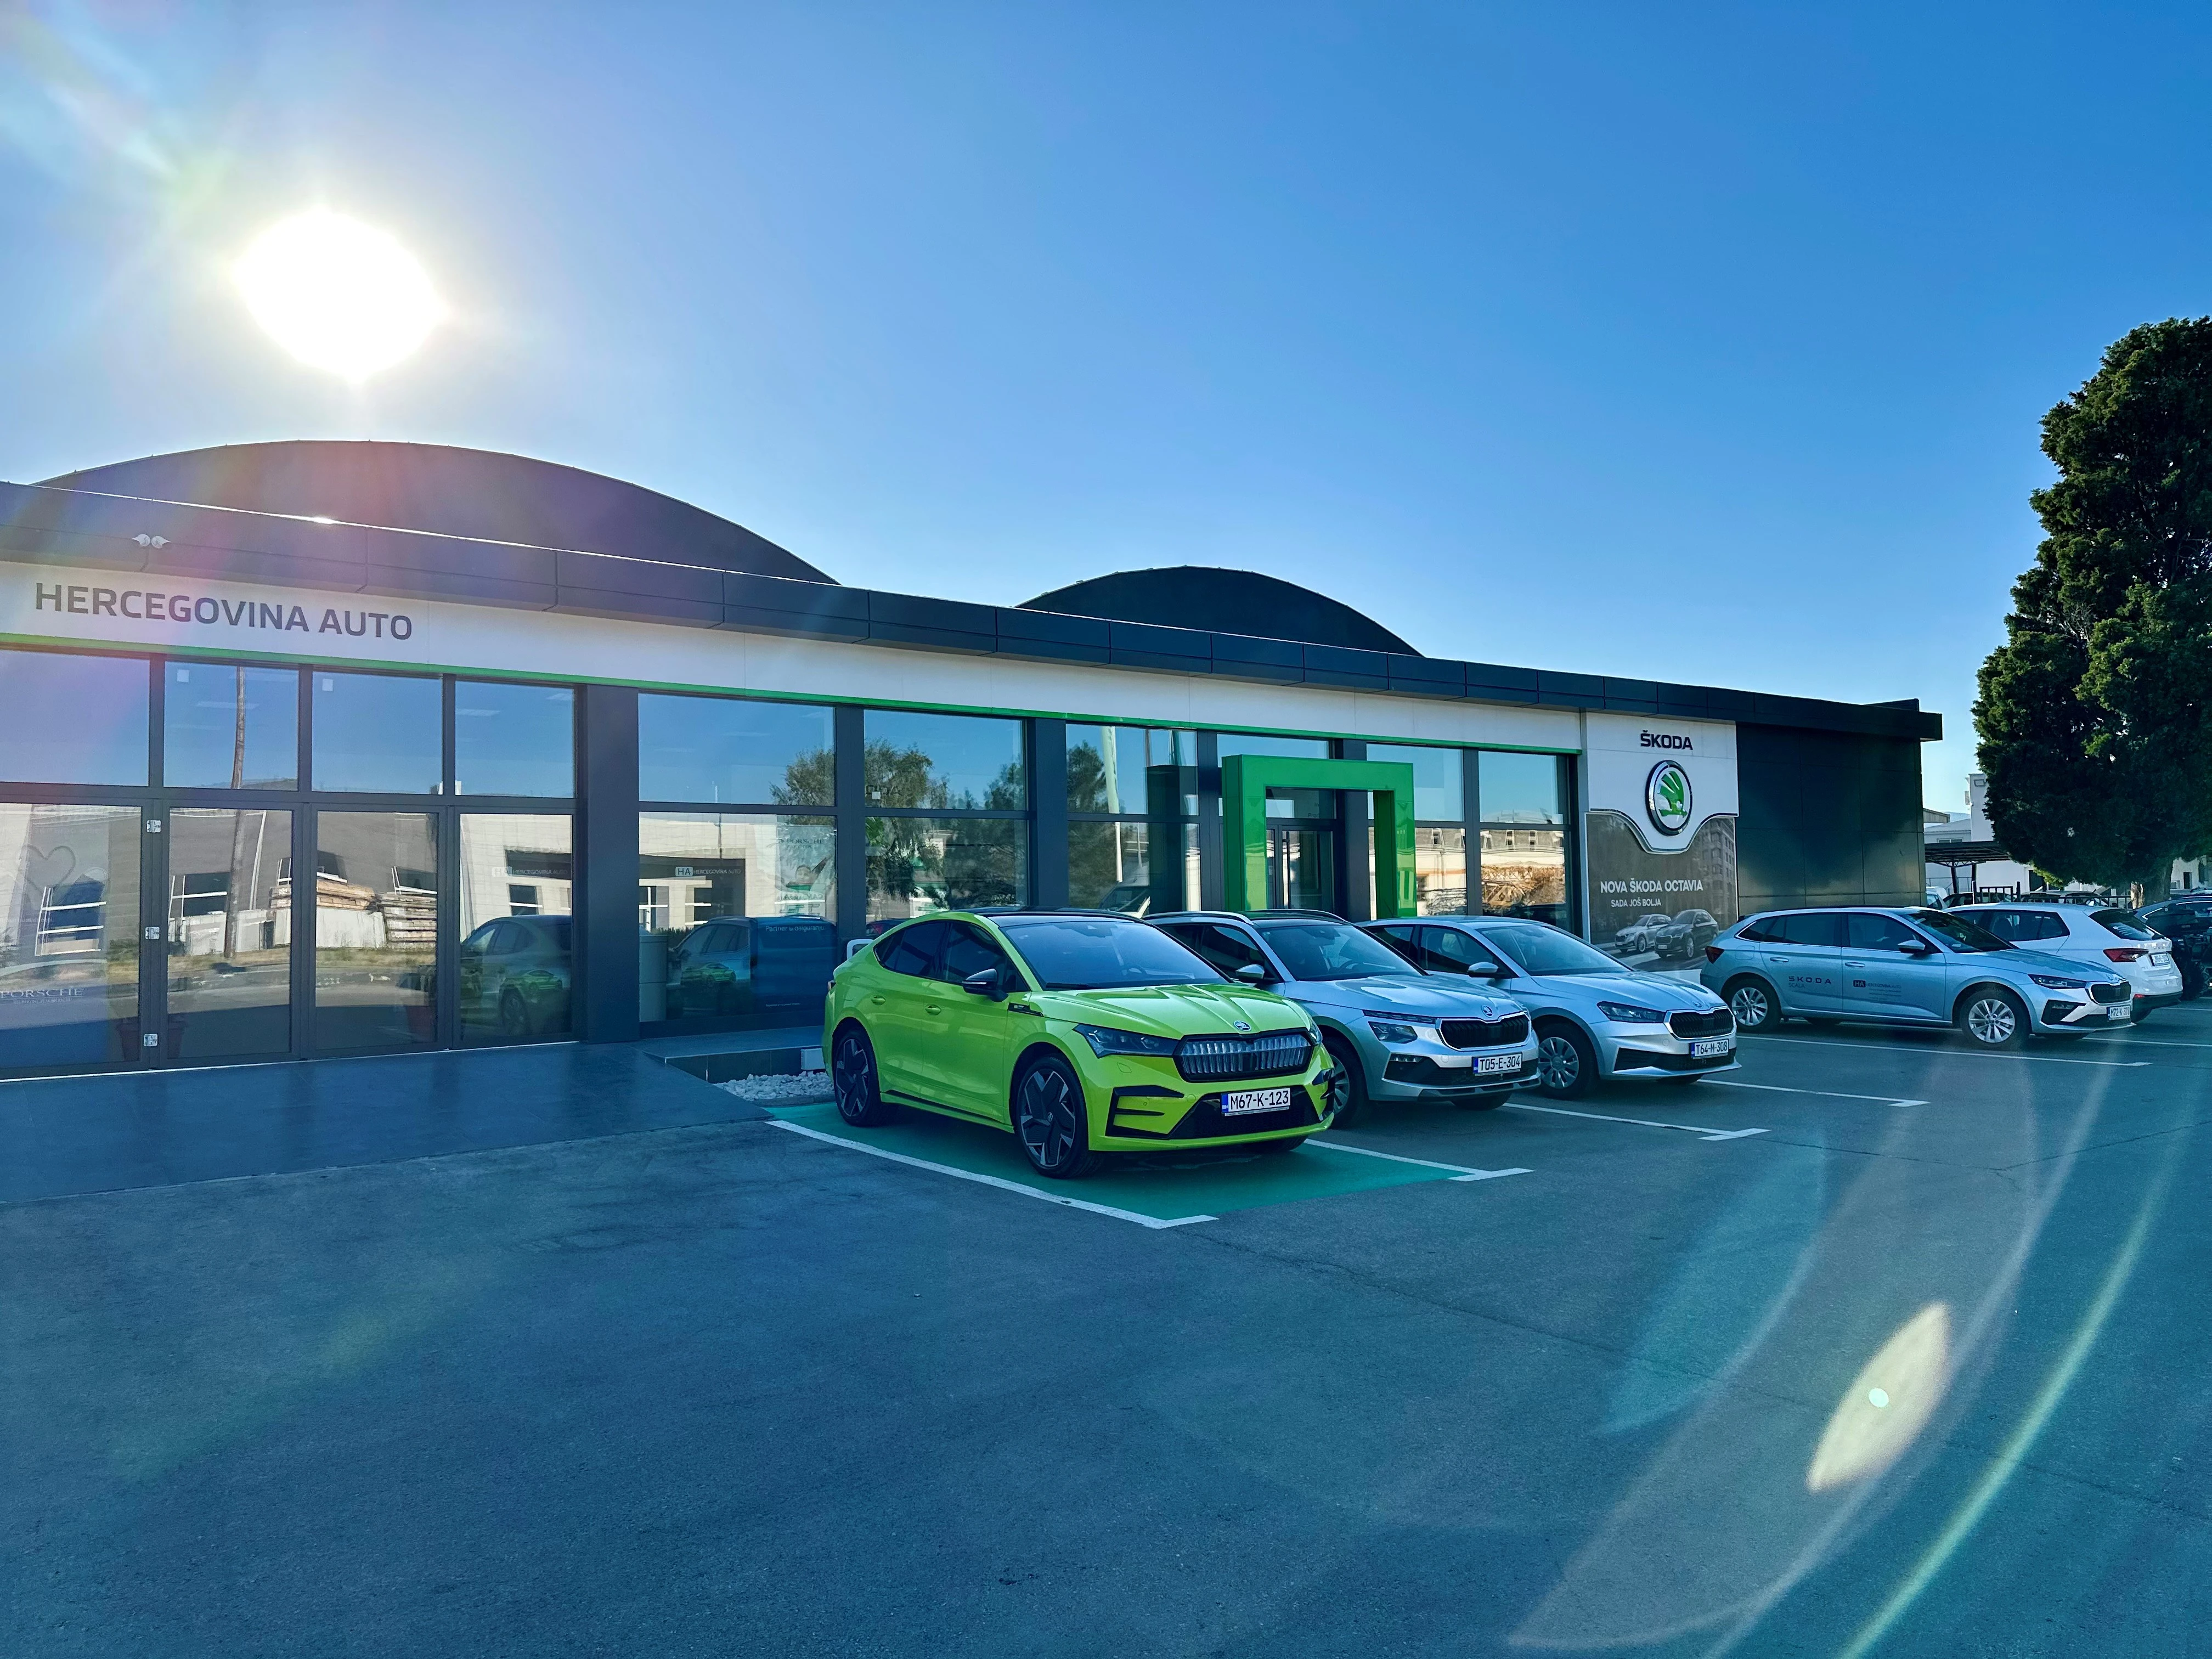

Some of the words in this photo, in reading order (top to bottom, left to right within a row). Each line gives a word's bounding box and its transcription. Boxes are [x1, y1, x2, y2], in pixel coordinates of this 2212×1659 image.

[36, 582, 309, 633] HERCEGOVINA
[318, 608, 413, 640] AUTO
[1640, 730, 1694, 751] ŠKODA
[678, 867, 691, 876] HA
[1600, 881, 1628, 894] NOVA
[1629, 878, 1663, 893] ŠKODA
[1664, 879, 1703, 892] OCTAVIA
[1611, 899, 1628, 907] SADA
[1629, 896, 1641, 907] JOŠ
[1642, 898, 1662, 907] BOLJA
[1480, 1055, 1520, 1071] T05-E-304
[1230, 1090, 1289, 1110] M67-K-123
